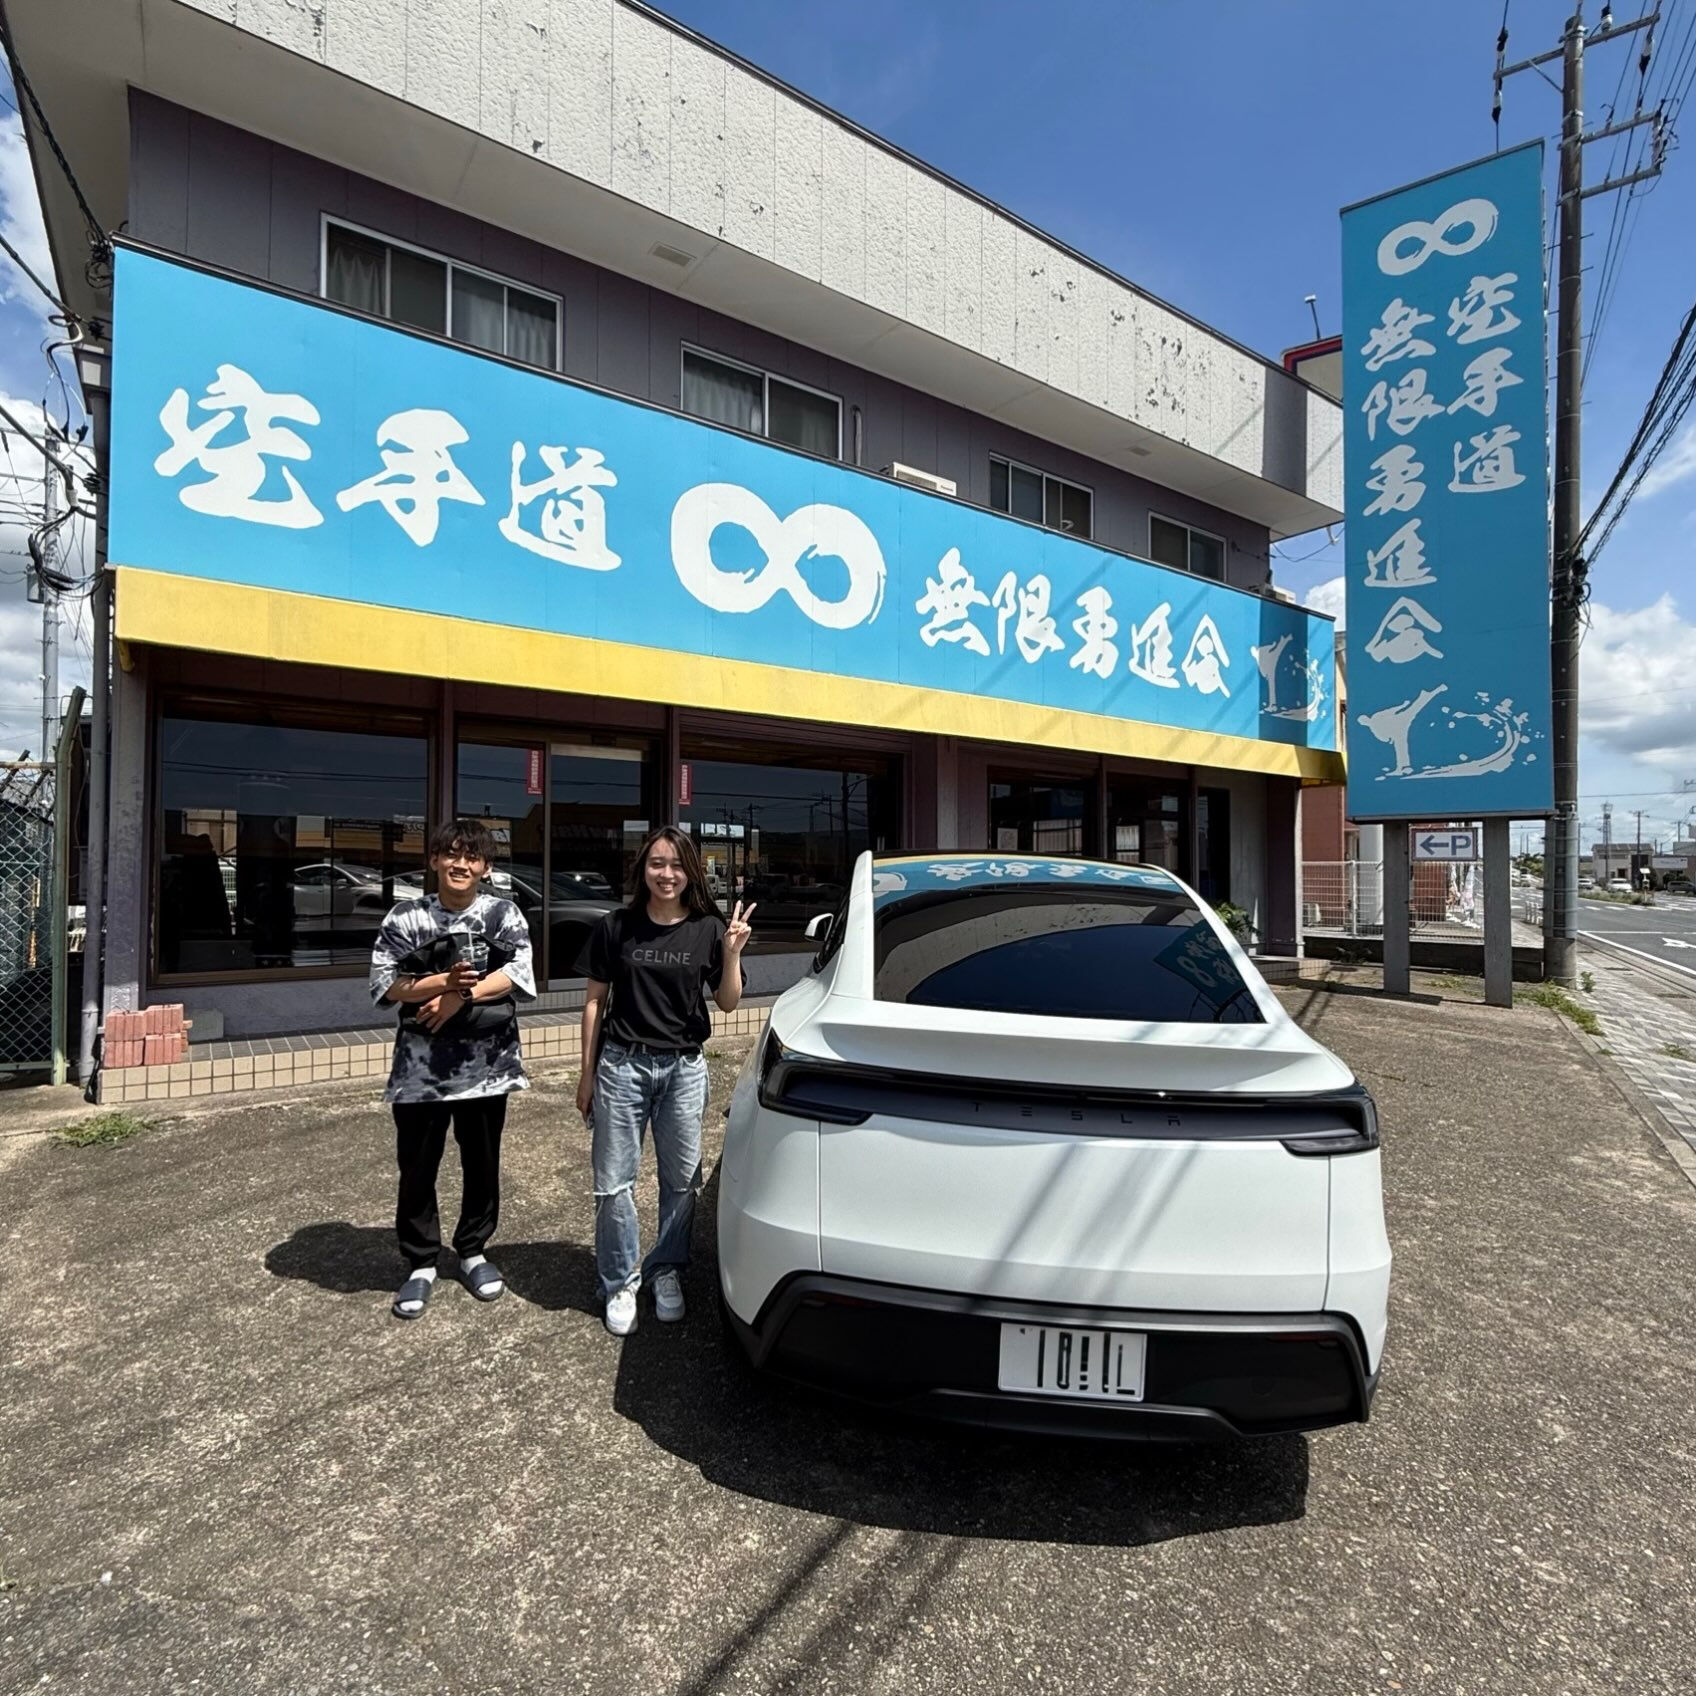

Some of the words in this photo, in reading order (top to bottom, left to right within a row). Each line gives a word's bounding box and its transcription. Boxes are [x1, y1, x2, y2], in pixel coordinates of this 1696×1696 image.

[1446, 272, 1525, 493] 空手道
[154, 363, 622, 571] 空手道
[1451, 835, 1472, 856] P
[632, 949, 691, 965] CELINE
[973, 1102, 1181, 1126] TESLA
